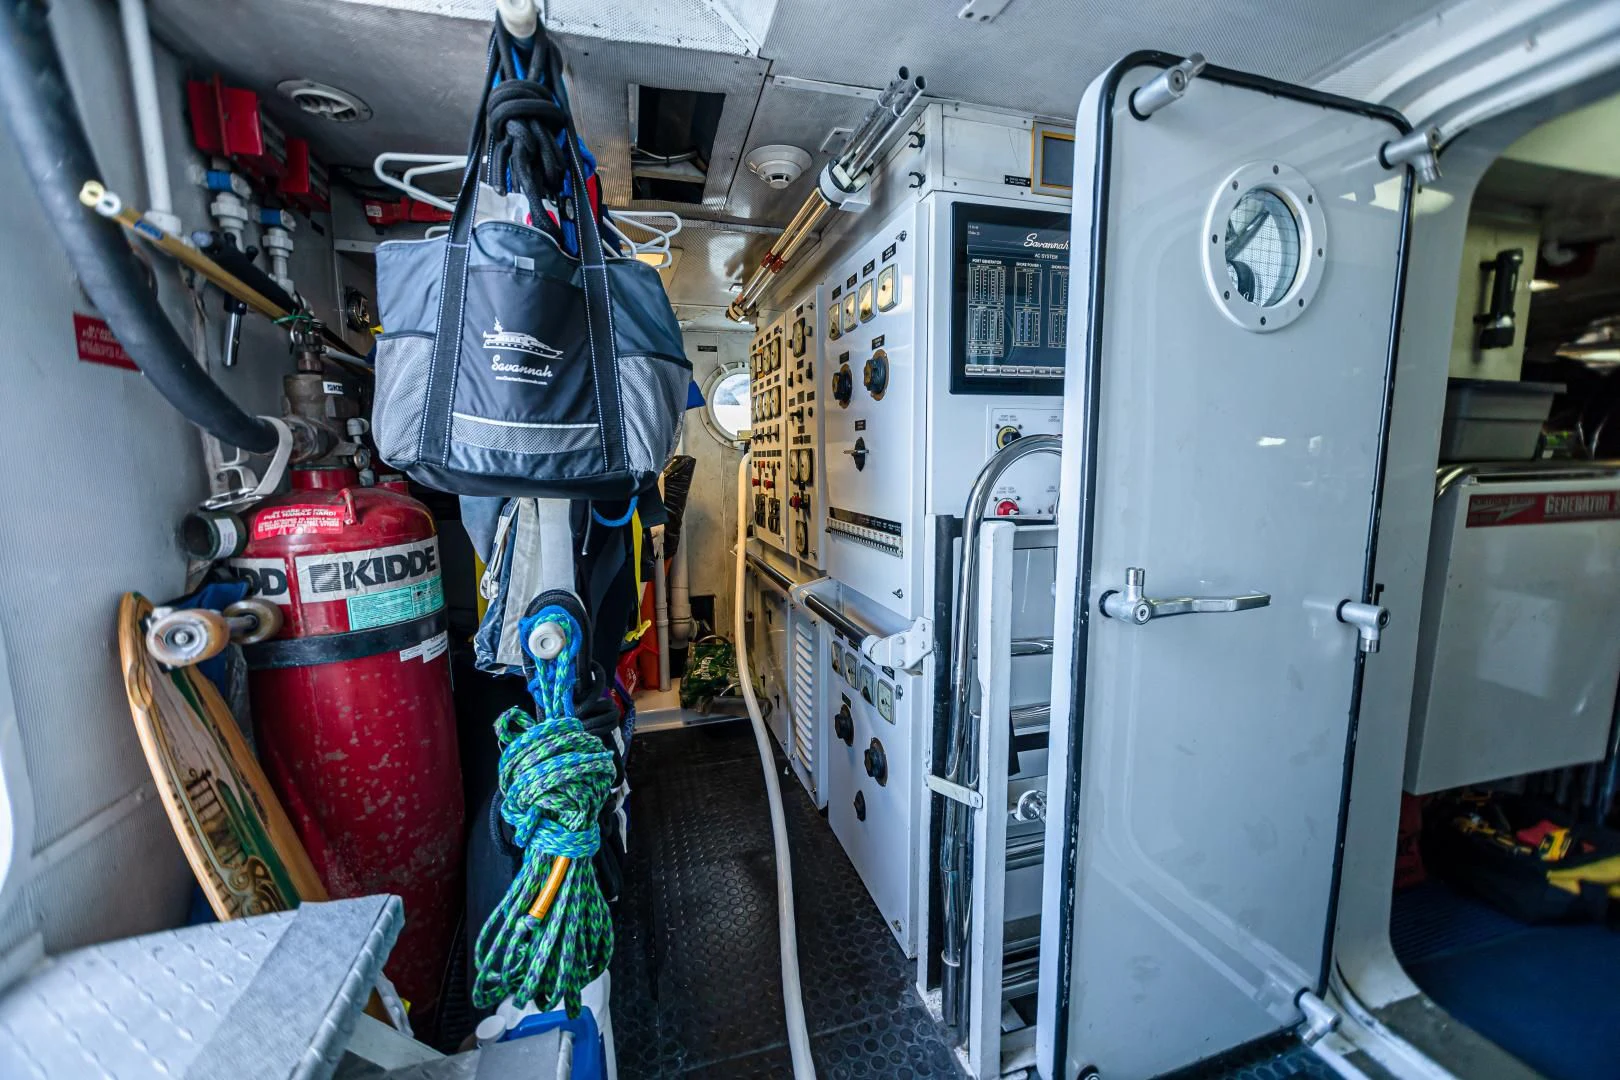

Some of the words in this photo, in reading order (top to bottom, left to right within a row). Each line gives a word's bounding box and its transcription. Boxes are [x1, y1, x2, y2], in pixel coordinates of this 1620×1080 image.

[1023, 233, 1069, 250] Savannah
[491, 354, 553, 377] Savannah
[342, 546, 436, 589] KIDDE
